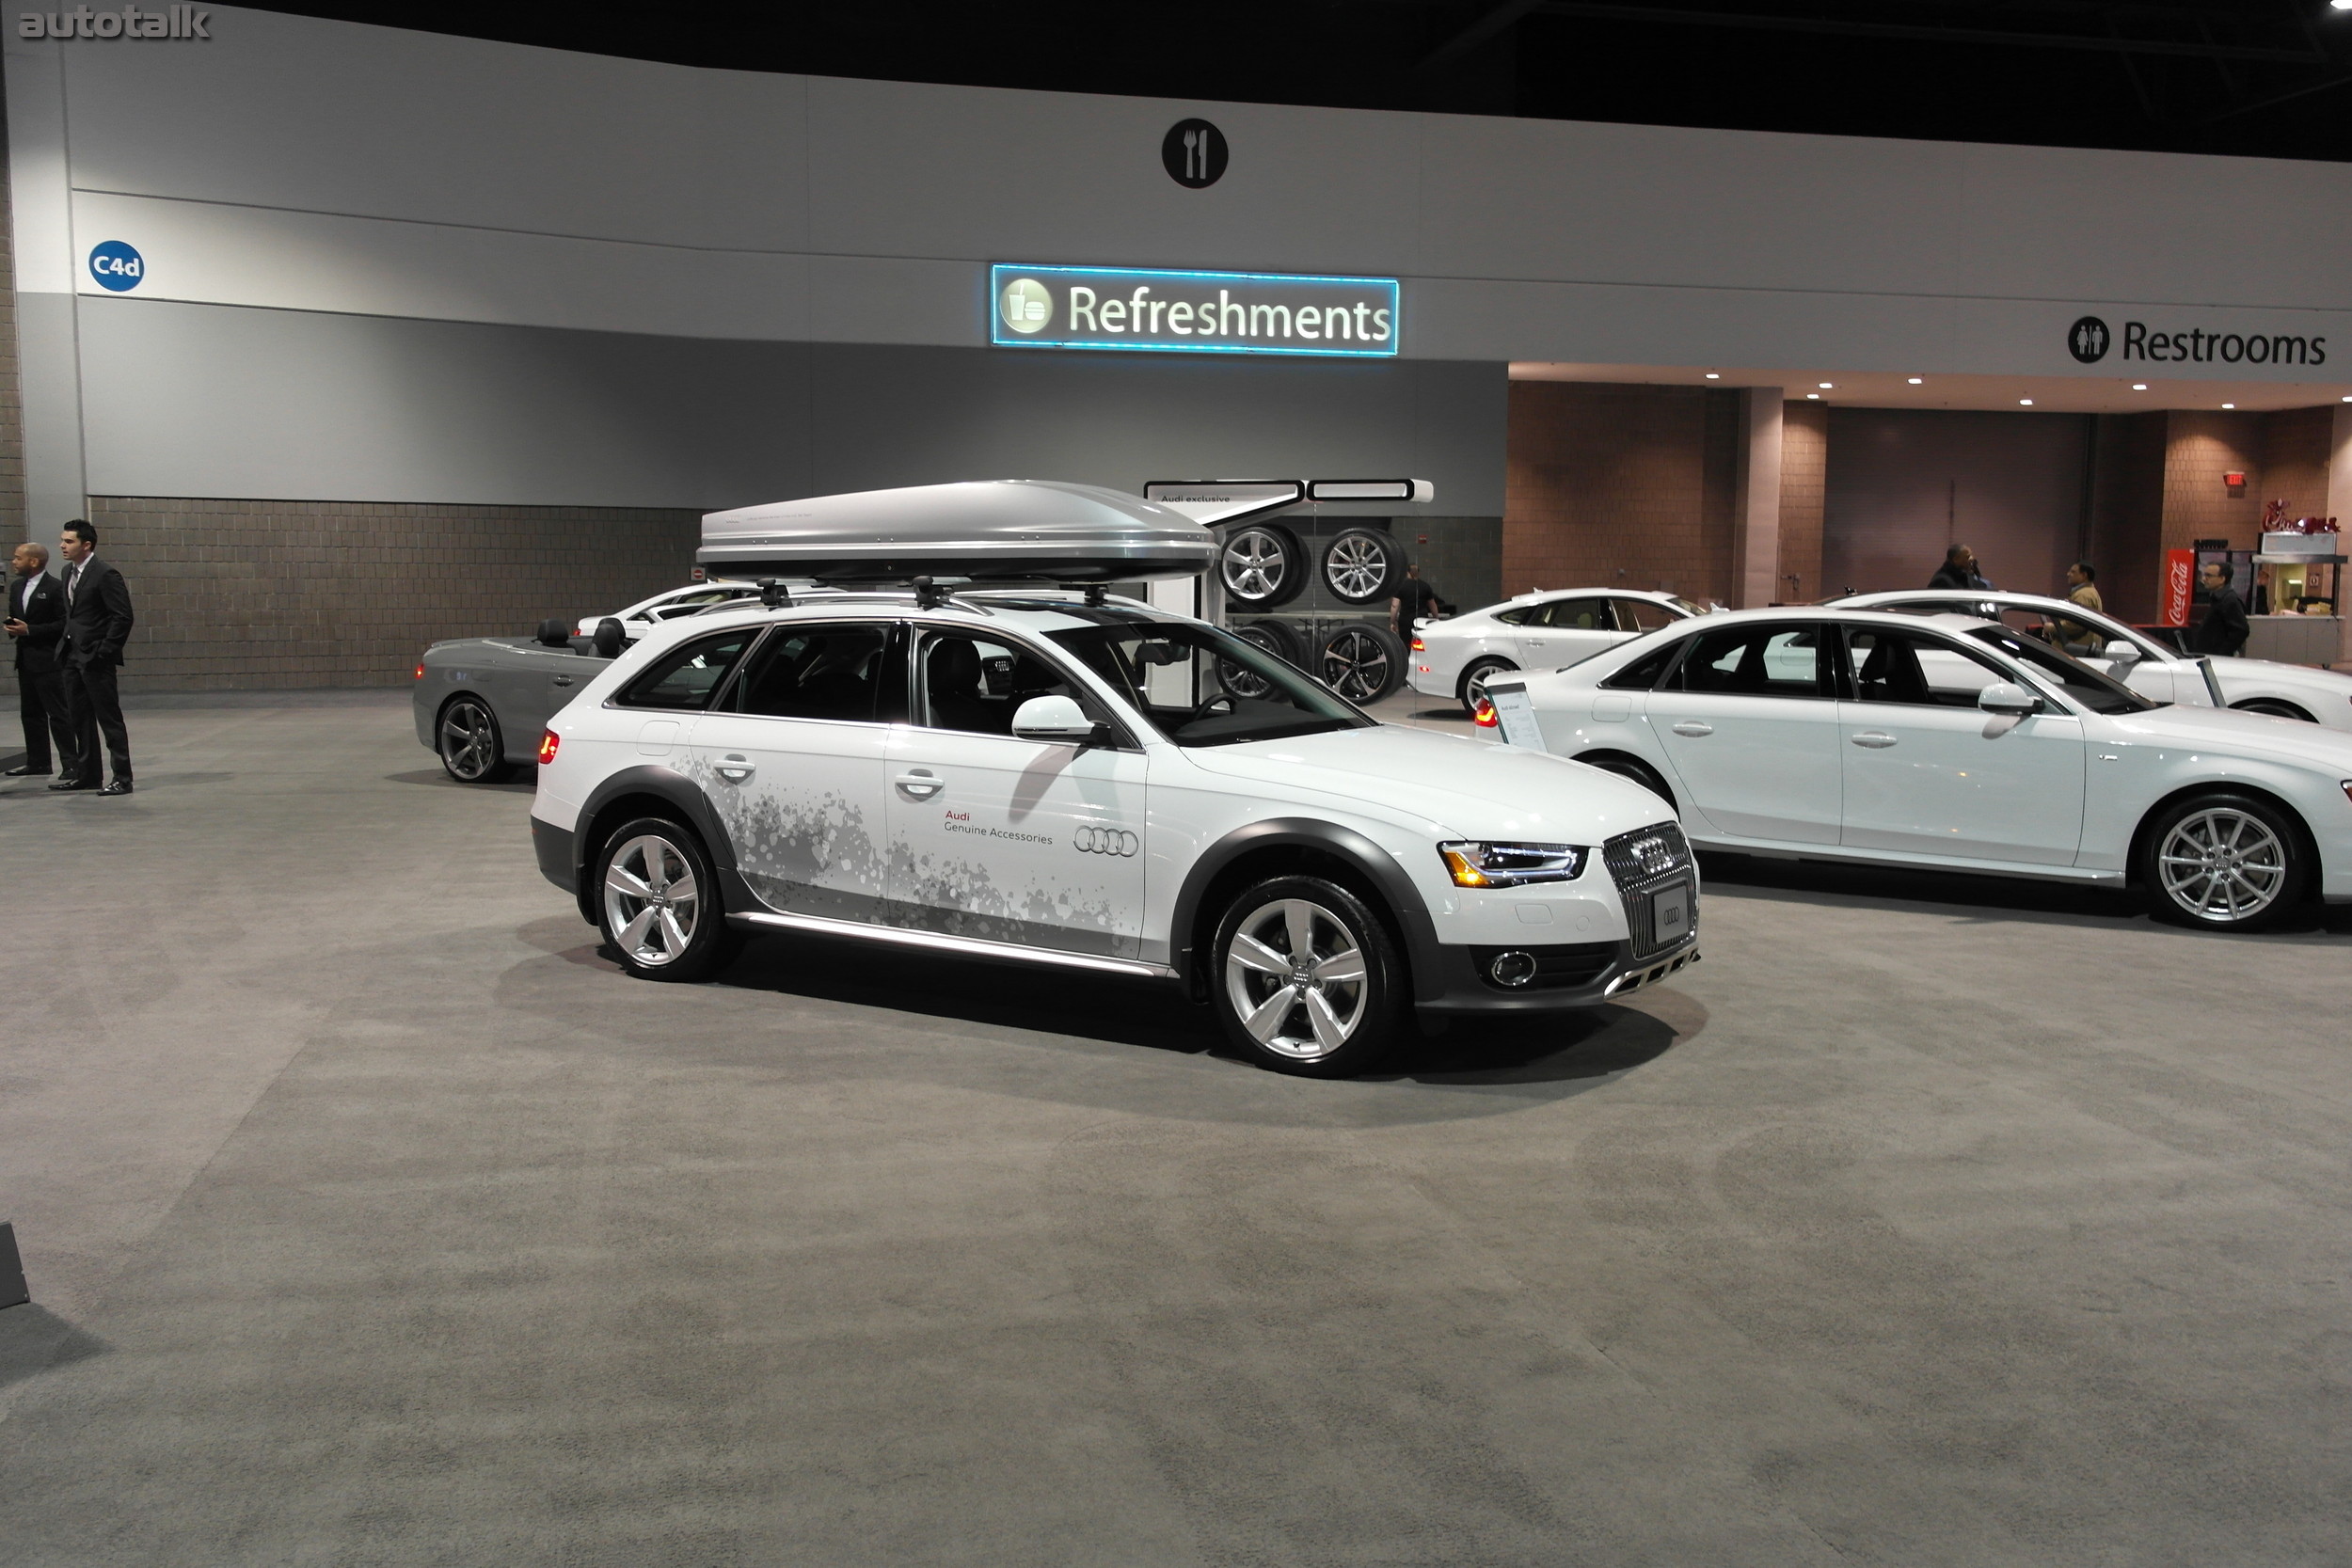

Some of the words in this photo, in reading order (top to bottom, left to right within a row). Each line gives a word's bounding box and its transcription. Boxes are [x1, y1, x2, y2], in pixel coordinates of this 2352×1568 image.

[93, 255, 140, 277] C4d
[1070, 286, 1391, 341] Refreshments
[2123, 322, 2327, 365] Restrooms
[946, 810, 971, 821] Audi
[944, 821, 987, 836] Genuine
[989, 828, 1053, 845] Accessories
